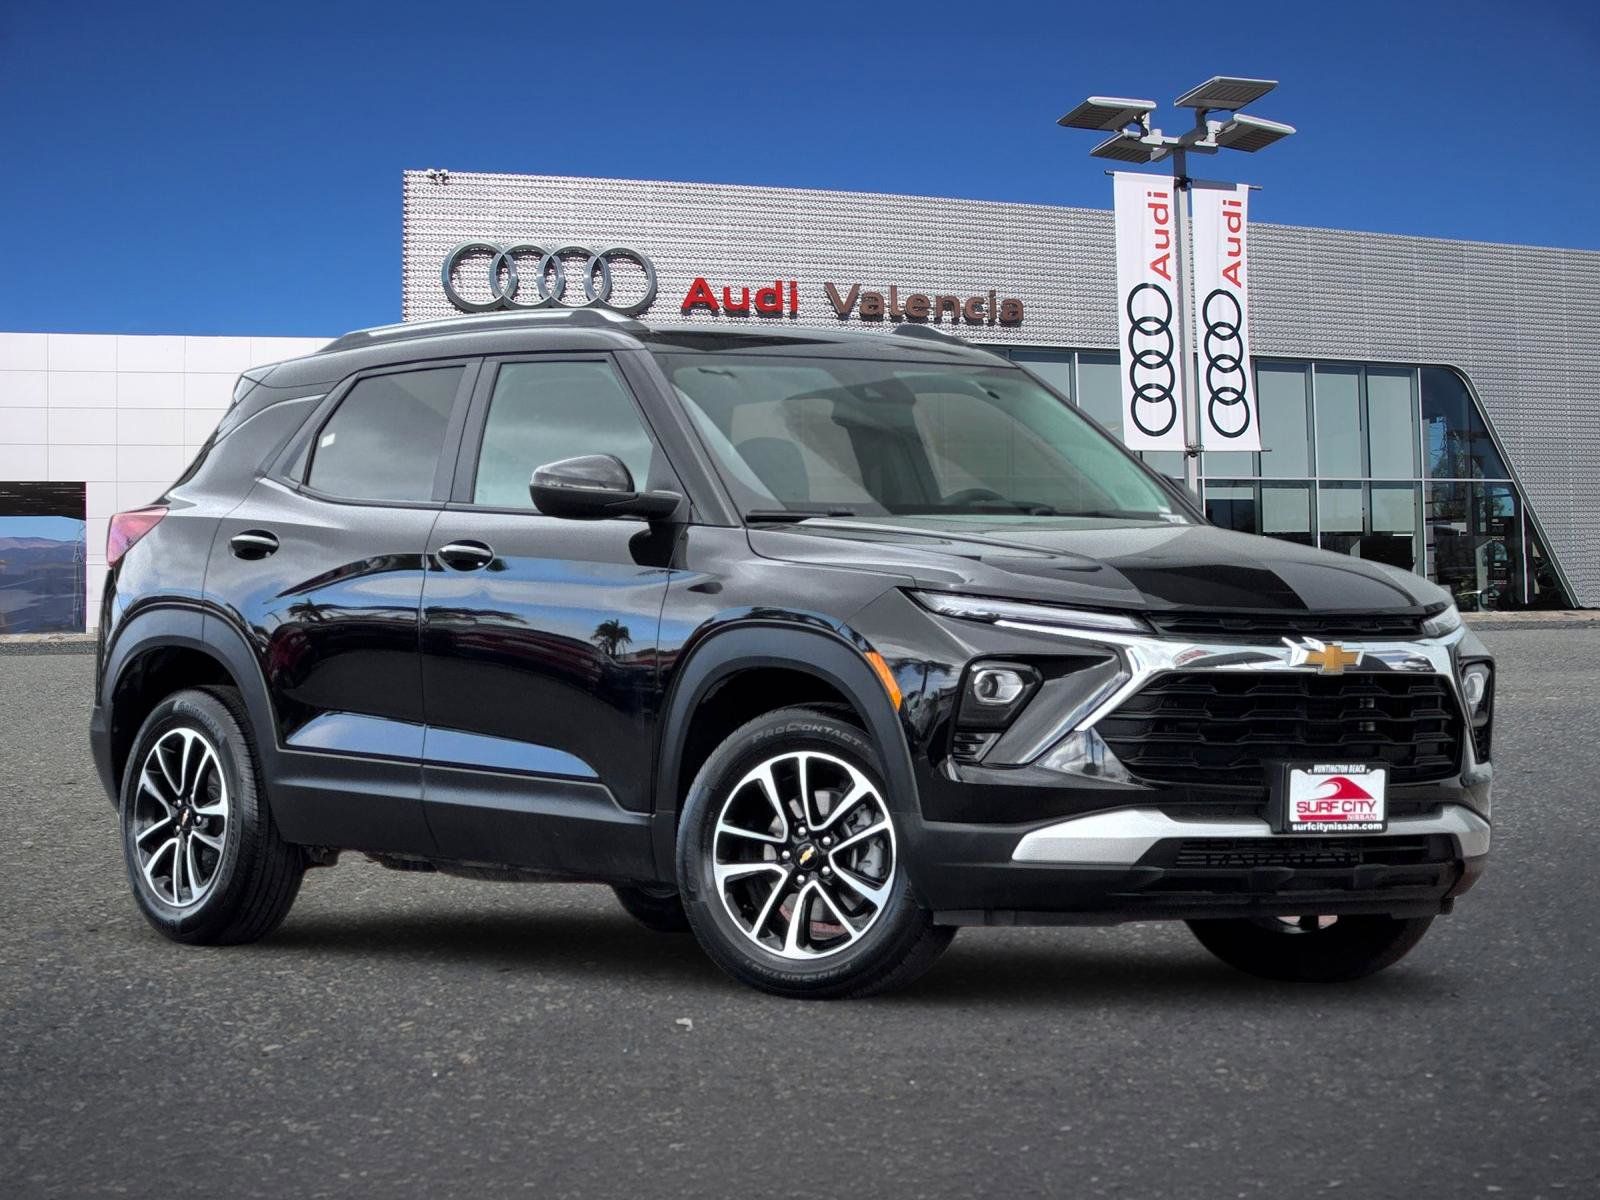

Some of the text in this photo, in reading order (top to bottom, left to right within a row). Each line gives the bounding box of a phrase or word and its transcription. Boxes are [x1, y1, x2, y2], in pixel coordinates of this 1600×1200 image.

[1147, 191, 1172, 282] Audi
[1221, 199, 1243, 289] Audi
[681, 277, 1024, 326] Audi Valencia
[1296, 800, 1377, 813] SURF CITY
[1346, 813, 1377, 821] NISSAN
[1291, 821, 1383, 832] surfcitynissan.com
